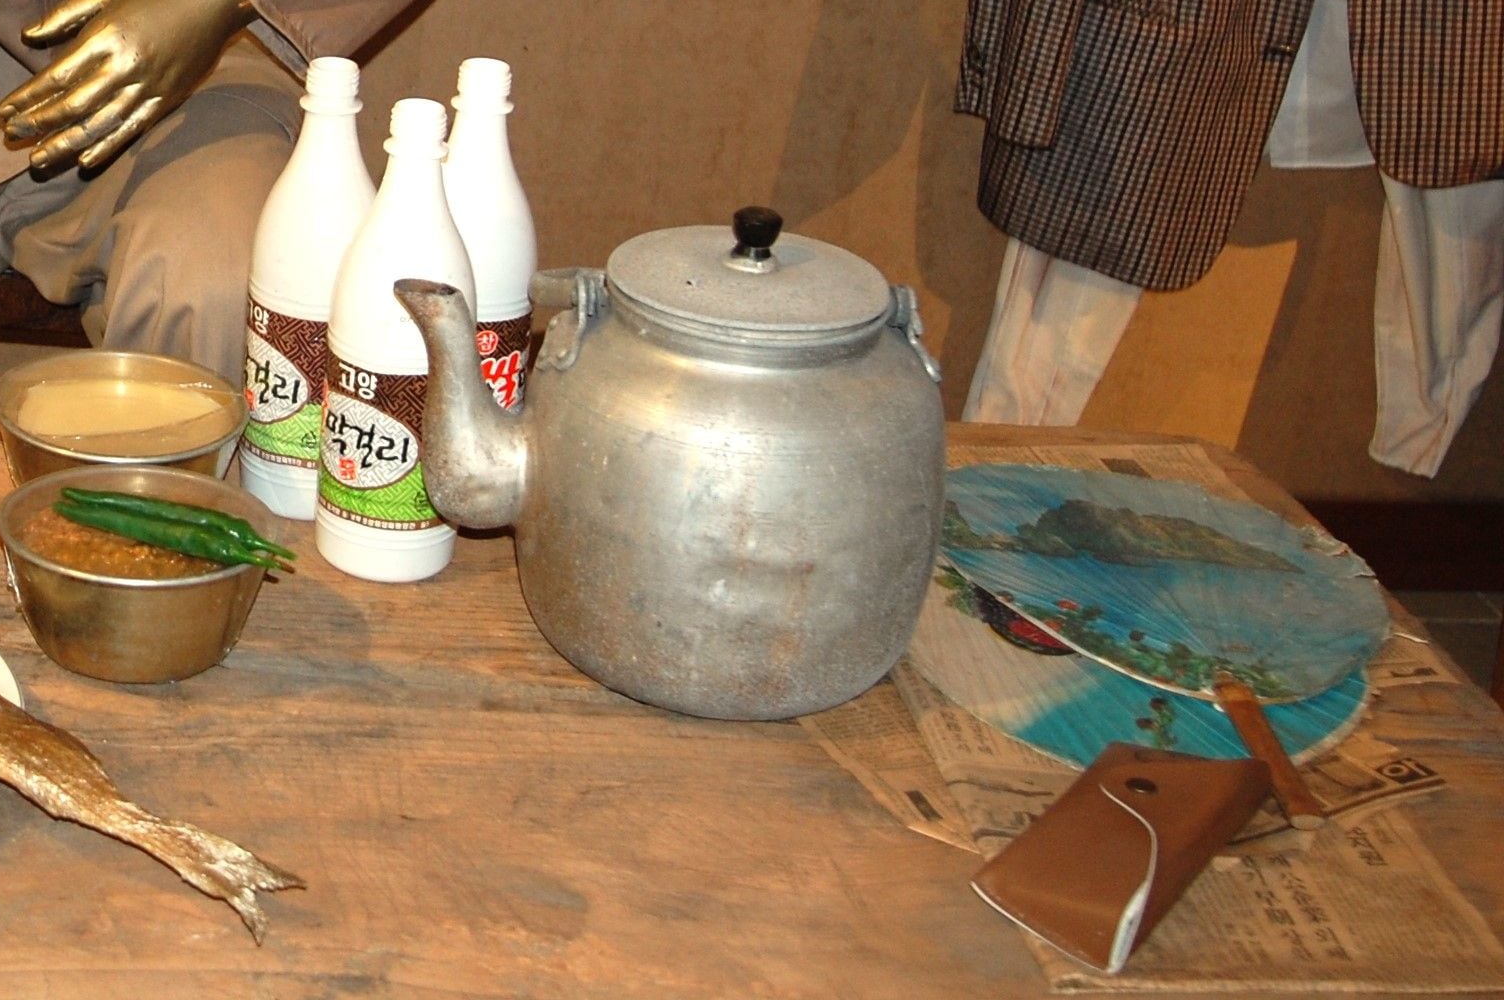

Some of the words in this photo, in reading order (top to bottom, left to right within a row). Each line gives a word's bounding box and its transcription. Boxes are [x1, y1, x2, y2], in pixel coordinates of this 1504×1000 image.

[246, 357, 301, 405] 걸리
[338, 361, 379, 400] 고양
[325, 410, 411, 469] 막걸리
